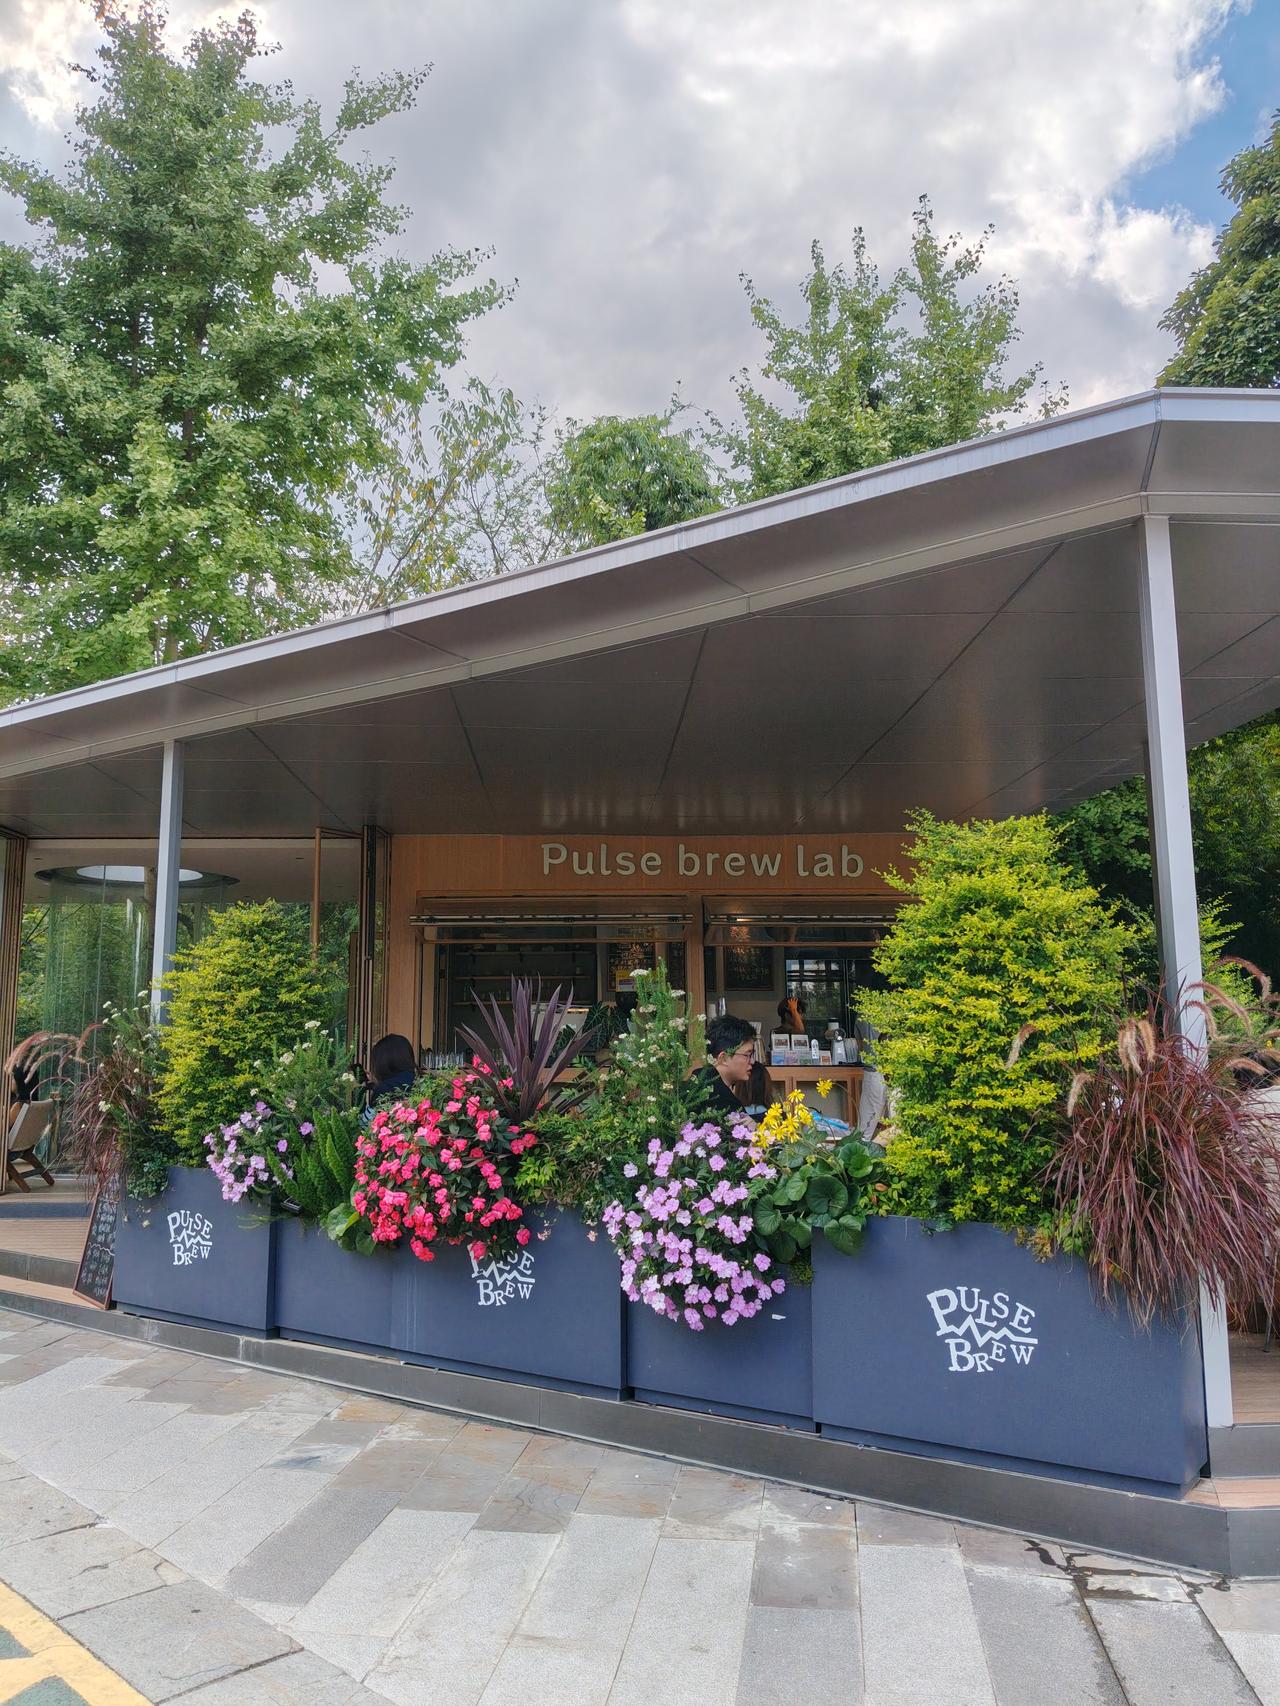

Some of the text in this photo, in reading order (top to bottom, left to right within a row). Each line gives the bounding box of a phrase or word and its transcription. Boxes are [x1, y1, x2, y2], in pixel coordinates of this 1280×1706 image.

[541, 843, 865, 878] Pulse brew lab
[167, 1210, 213, 1243] PULSE
[172, 1244, 211, 1265] BREW
[476, 1280, 533, 1306] BREW
[926, 1286, 1036, 1337] PULSE
[944, 1338, 1035, 1373] BREW
